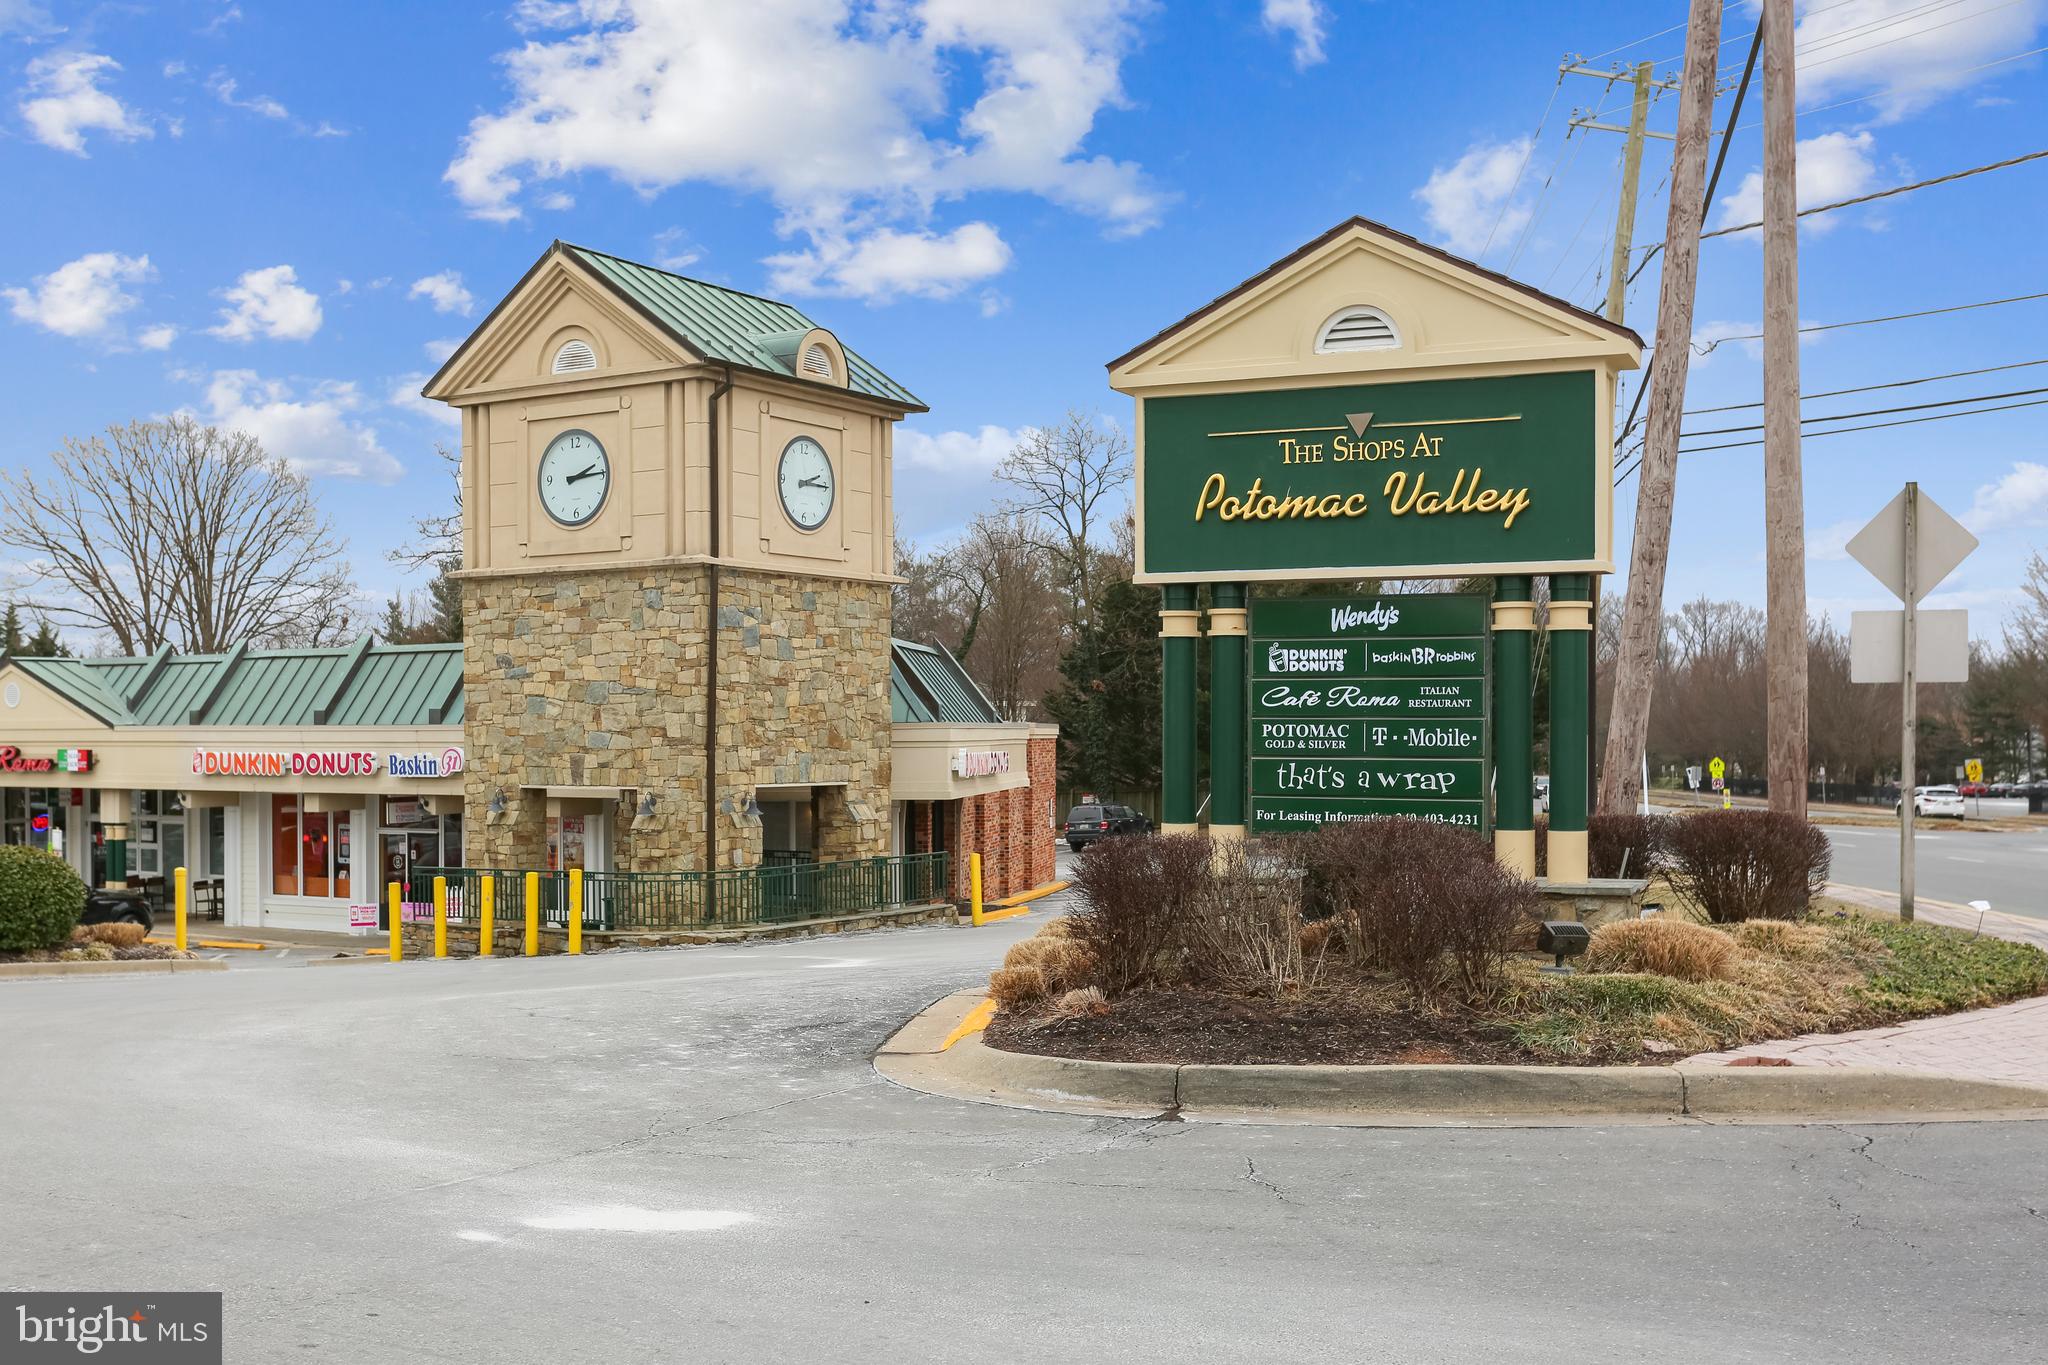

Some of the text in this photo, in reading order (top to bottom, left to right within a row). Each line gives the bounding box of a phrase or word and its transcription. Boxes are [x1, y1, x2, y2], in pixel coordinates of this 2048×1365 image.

[570, 436, 581, 449] 12
[800, 443, 809, 455] 12
[546, 475, 553, 487] 9
[1195, 467, 1530, 530] Potomac Valley
[573, 507, 580, 520] 6
[801, 512, 807, 523] 6
[1331, 601, 1400, 633] Wendy's
[1289, 648, 1348, 661] DUNKIN'
[1411, 647, 1436, 665] BR
[1289, 660, 1345, 672] DONUTS
[1419, 686, 1460, 695] ITALIAN
[1261, 686, 1401, 709] Café Roma
[1408, 698, 1473, 708] RESTAURANT
[1262, 724, 1350, 738] POTOMAC
[1264, 739, 1347, 749] GOLD & SILVER
[205, 752, 373, 775] DUNKIN' DONUTS
[388, 754, 438, 776] Baskin
[1277, 762, 1456, 794] that's a wrap
[1256, 809, 1277, 821] For
[1279, 810, 1322, 825] Leasing
